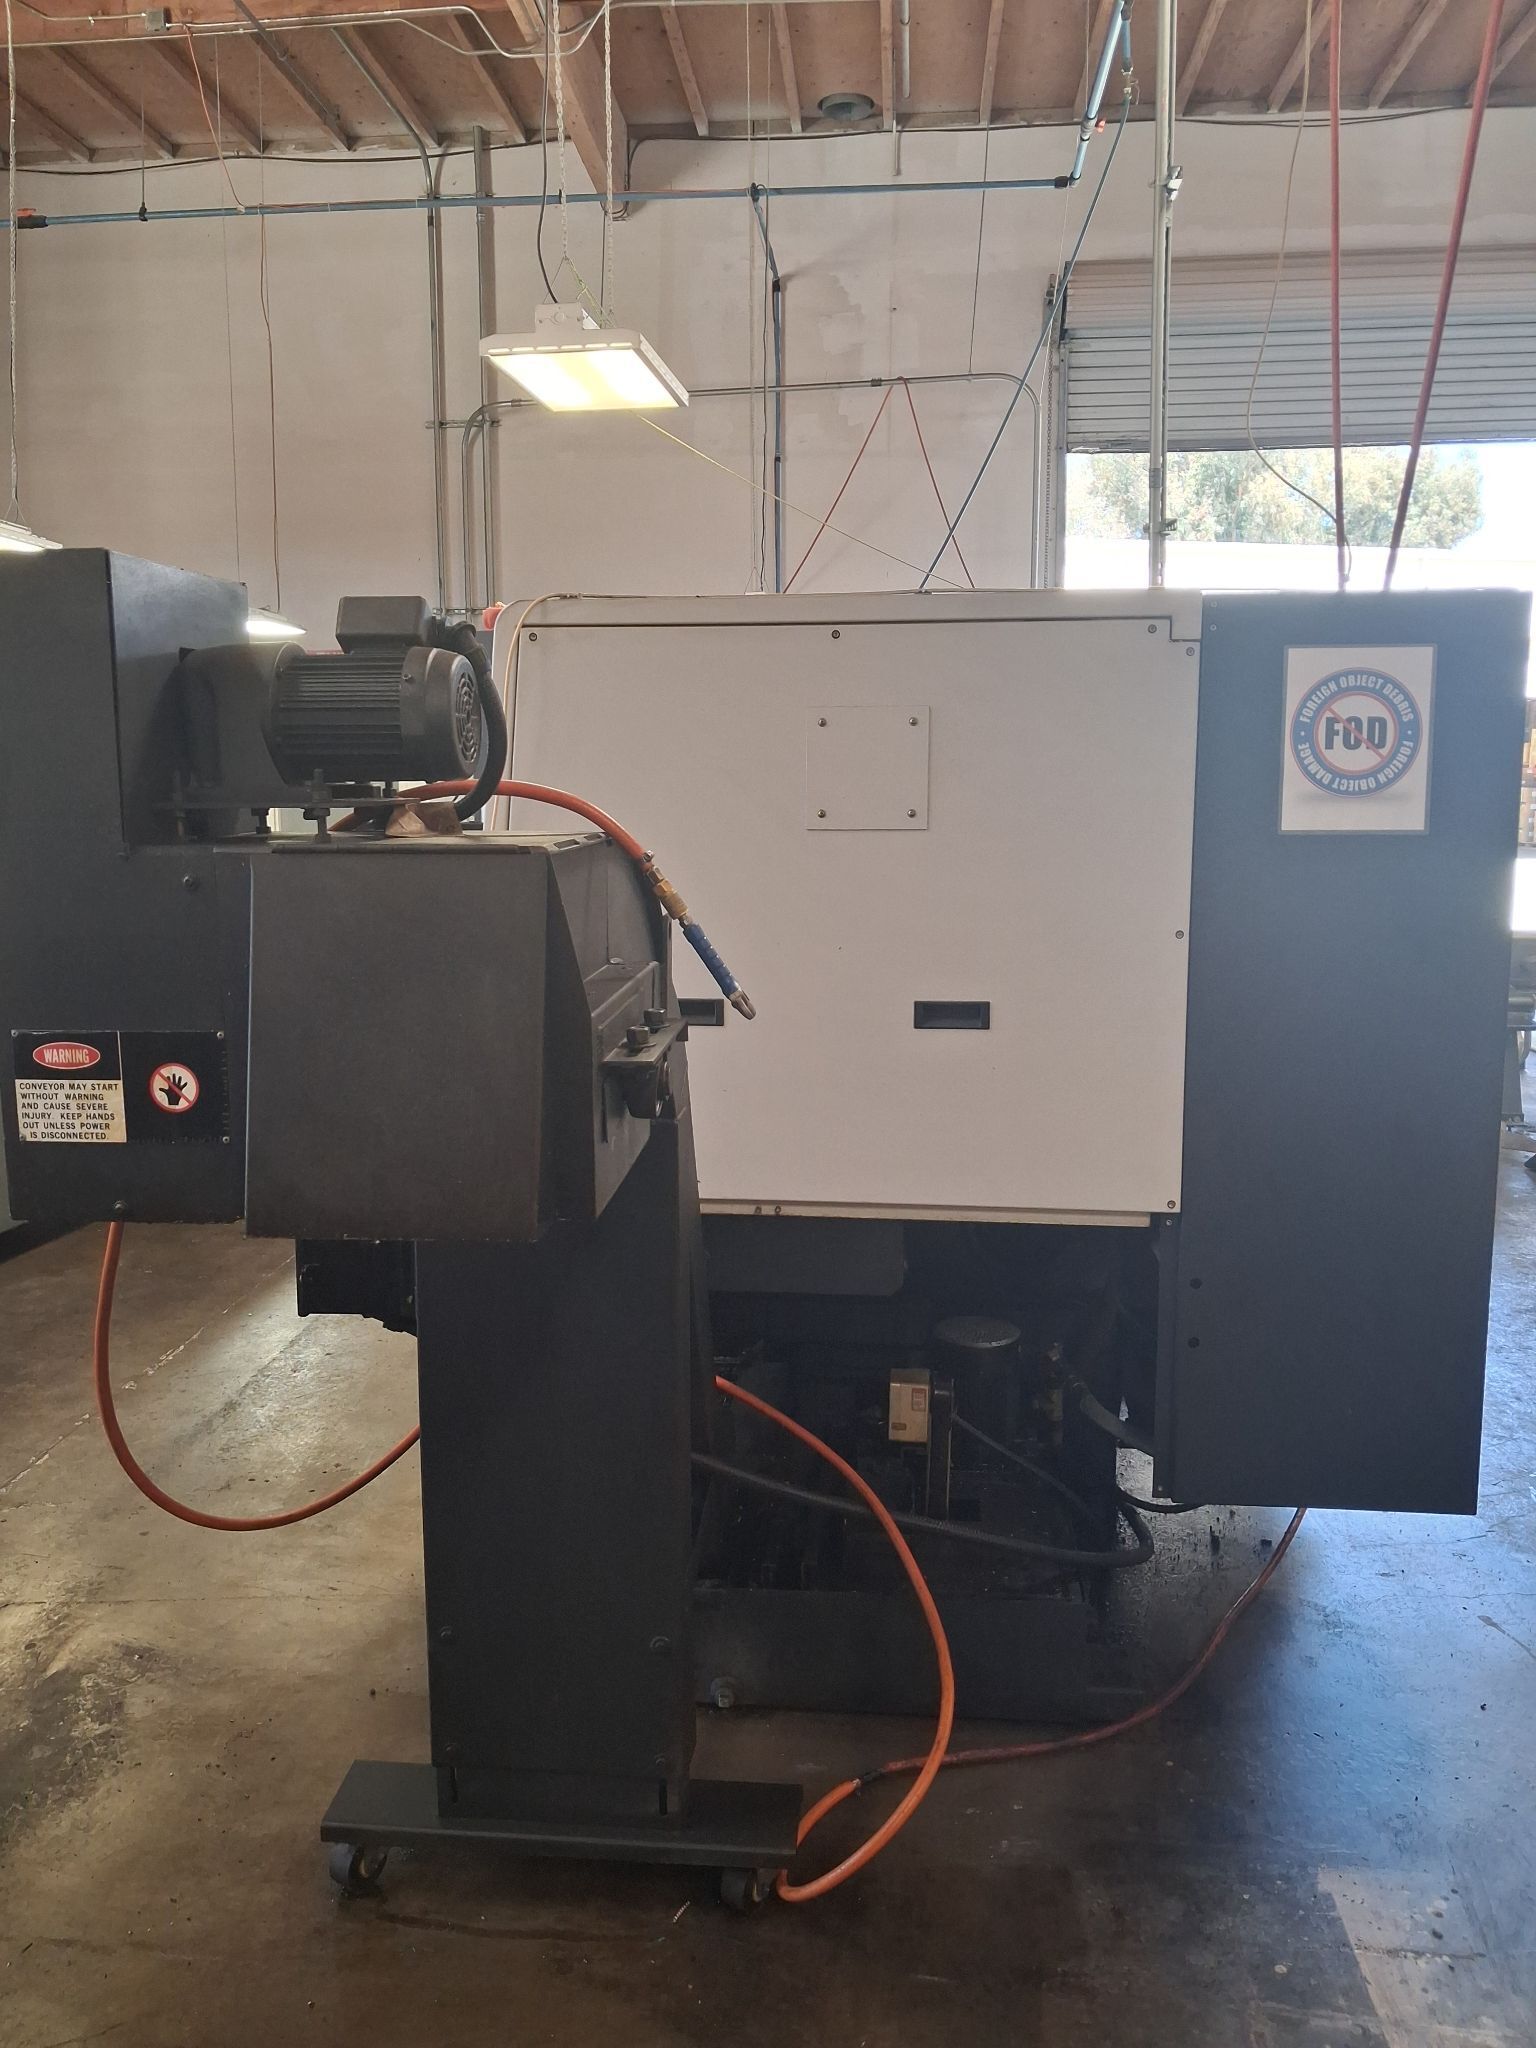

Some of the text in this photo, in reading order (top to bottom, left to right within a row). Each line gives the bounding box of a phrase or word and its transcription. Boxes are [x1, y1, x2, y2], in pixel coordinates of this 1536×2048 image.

[1300, 674, 1415, 723] FOREIGN OBJECT DEBRIS
[1324, 715, 1388, 750] FOD
[1298, 740, 1414, 792] FOREIGN OBJECT DAMAGE
[43, 1049, 90, 1064] WARNING
[20, 1082, 119, 1091] CONVEYOR MAY START
[21, 1092, 104, 1101] WITHOUT WARNING
[21, 1102, 109, 1111] AND CAUSE SEVERE
[86, 1113, 115, 1121] HANDS
[23, 1122, 111, 1131] OUT UNLESS POWER
[30, 1131, 38, 1139] IS
